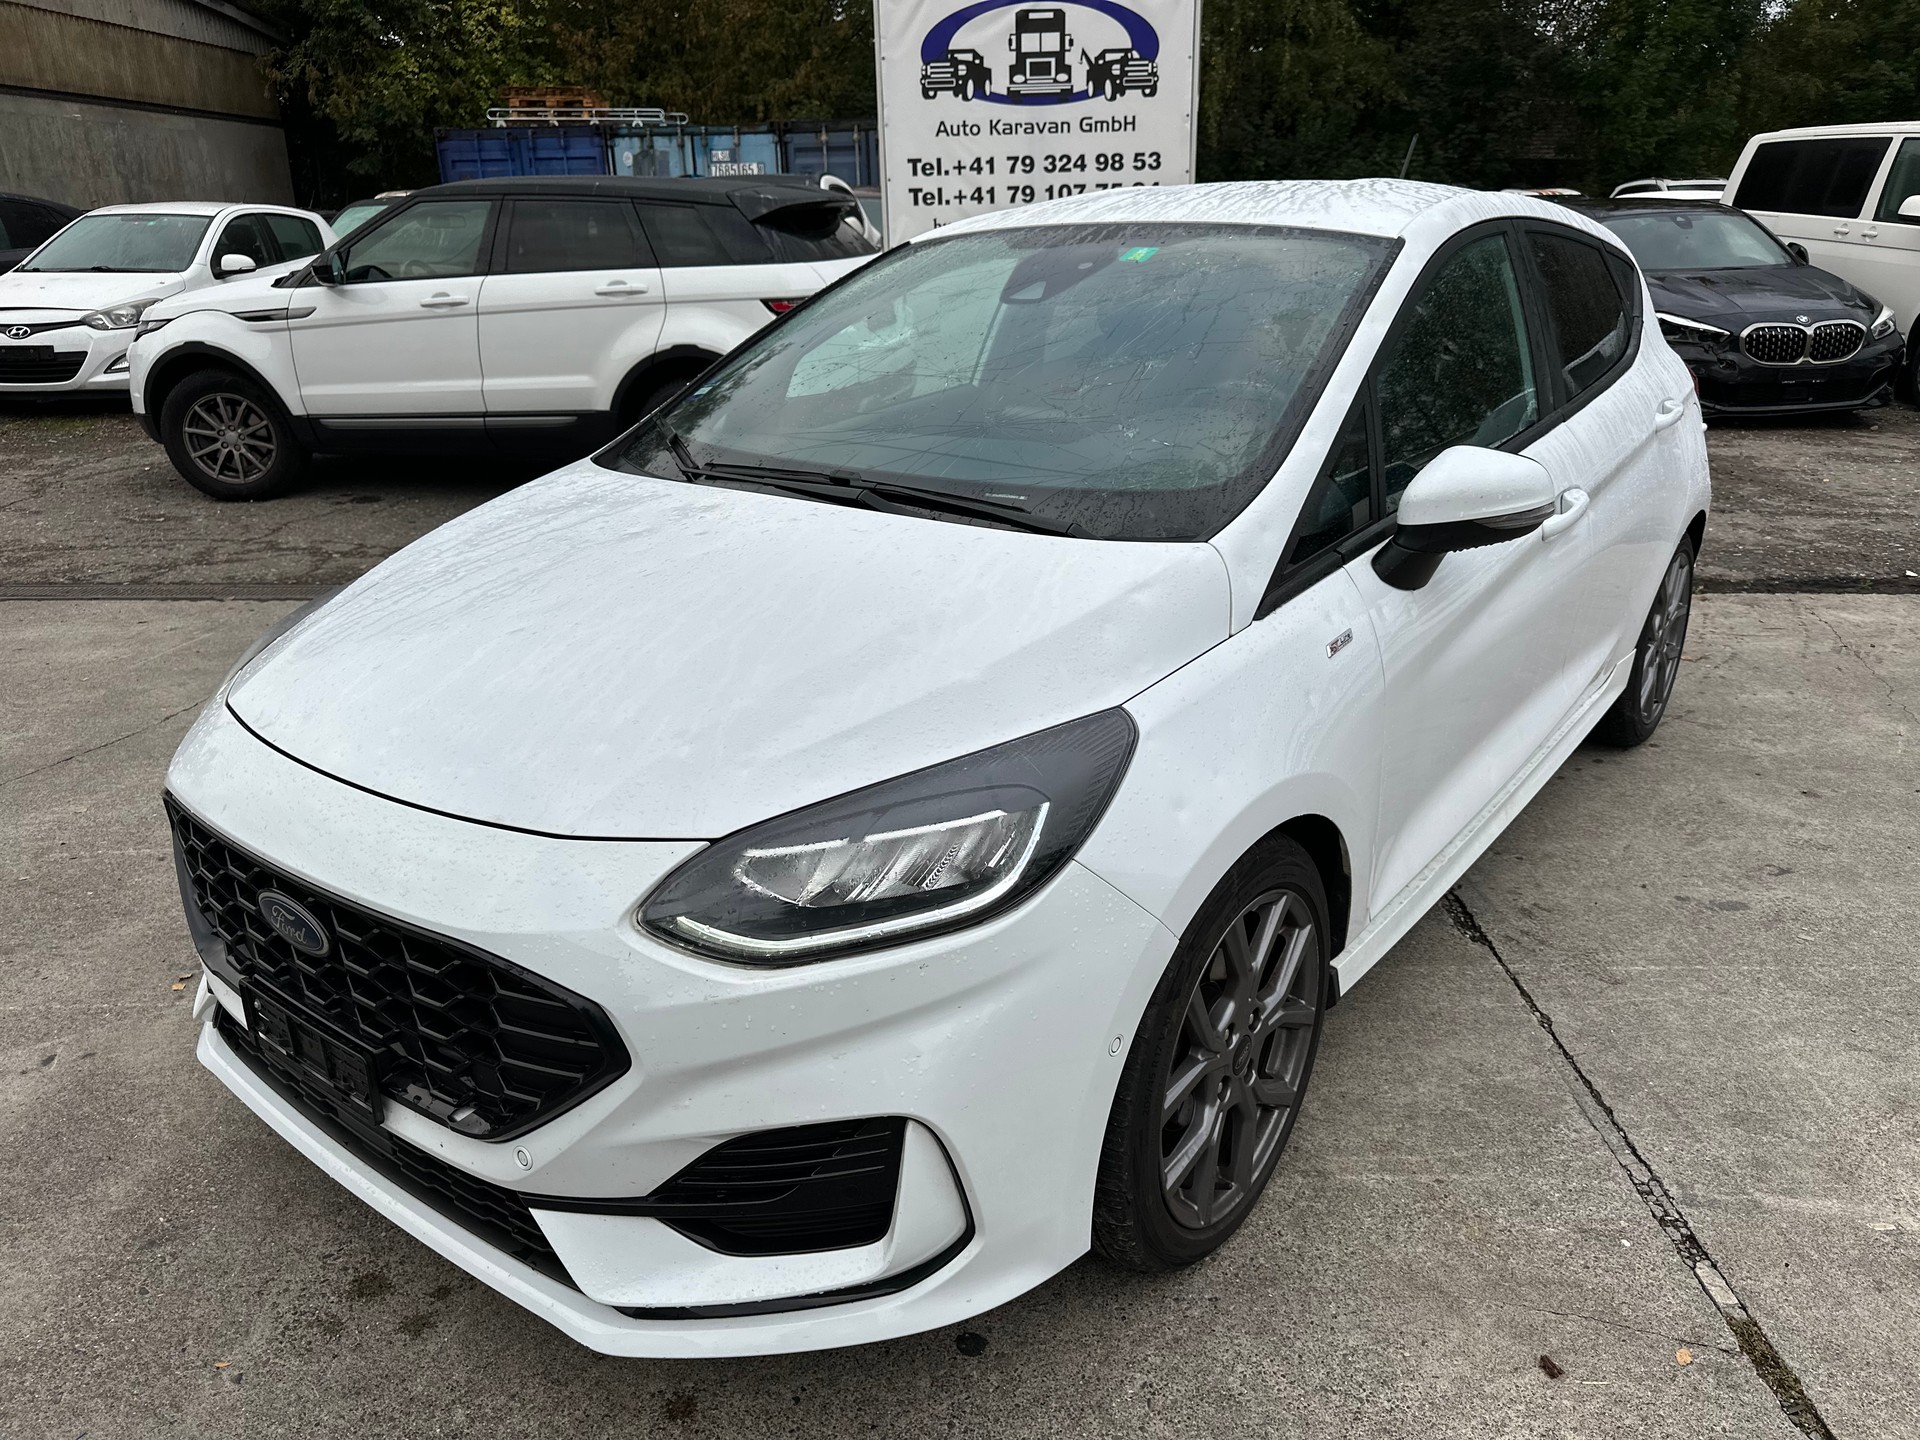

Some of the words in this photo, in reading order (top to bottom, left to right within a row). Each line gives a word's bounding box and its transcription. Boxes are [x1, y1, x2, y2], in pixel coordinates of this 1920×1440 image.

[935, 120, 981, 138] Auto
[989, 118, 1071, 136] Karavan
[1079, 115, 1136, 133] GmbH
[1006, 155, 1035, 175] 79
[1043, 154, 1087, 173] 324
[1095, 153, 1125, 172] 98
[1132, 151, 1162, 171] 53
[1006, 185, 1036, 205] 79
[271, 905, 308, 945] Ford
